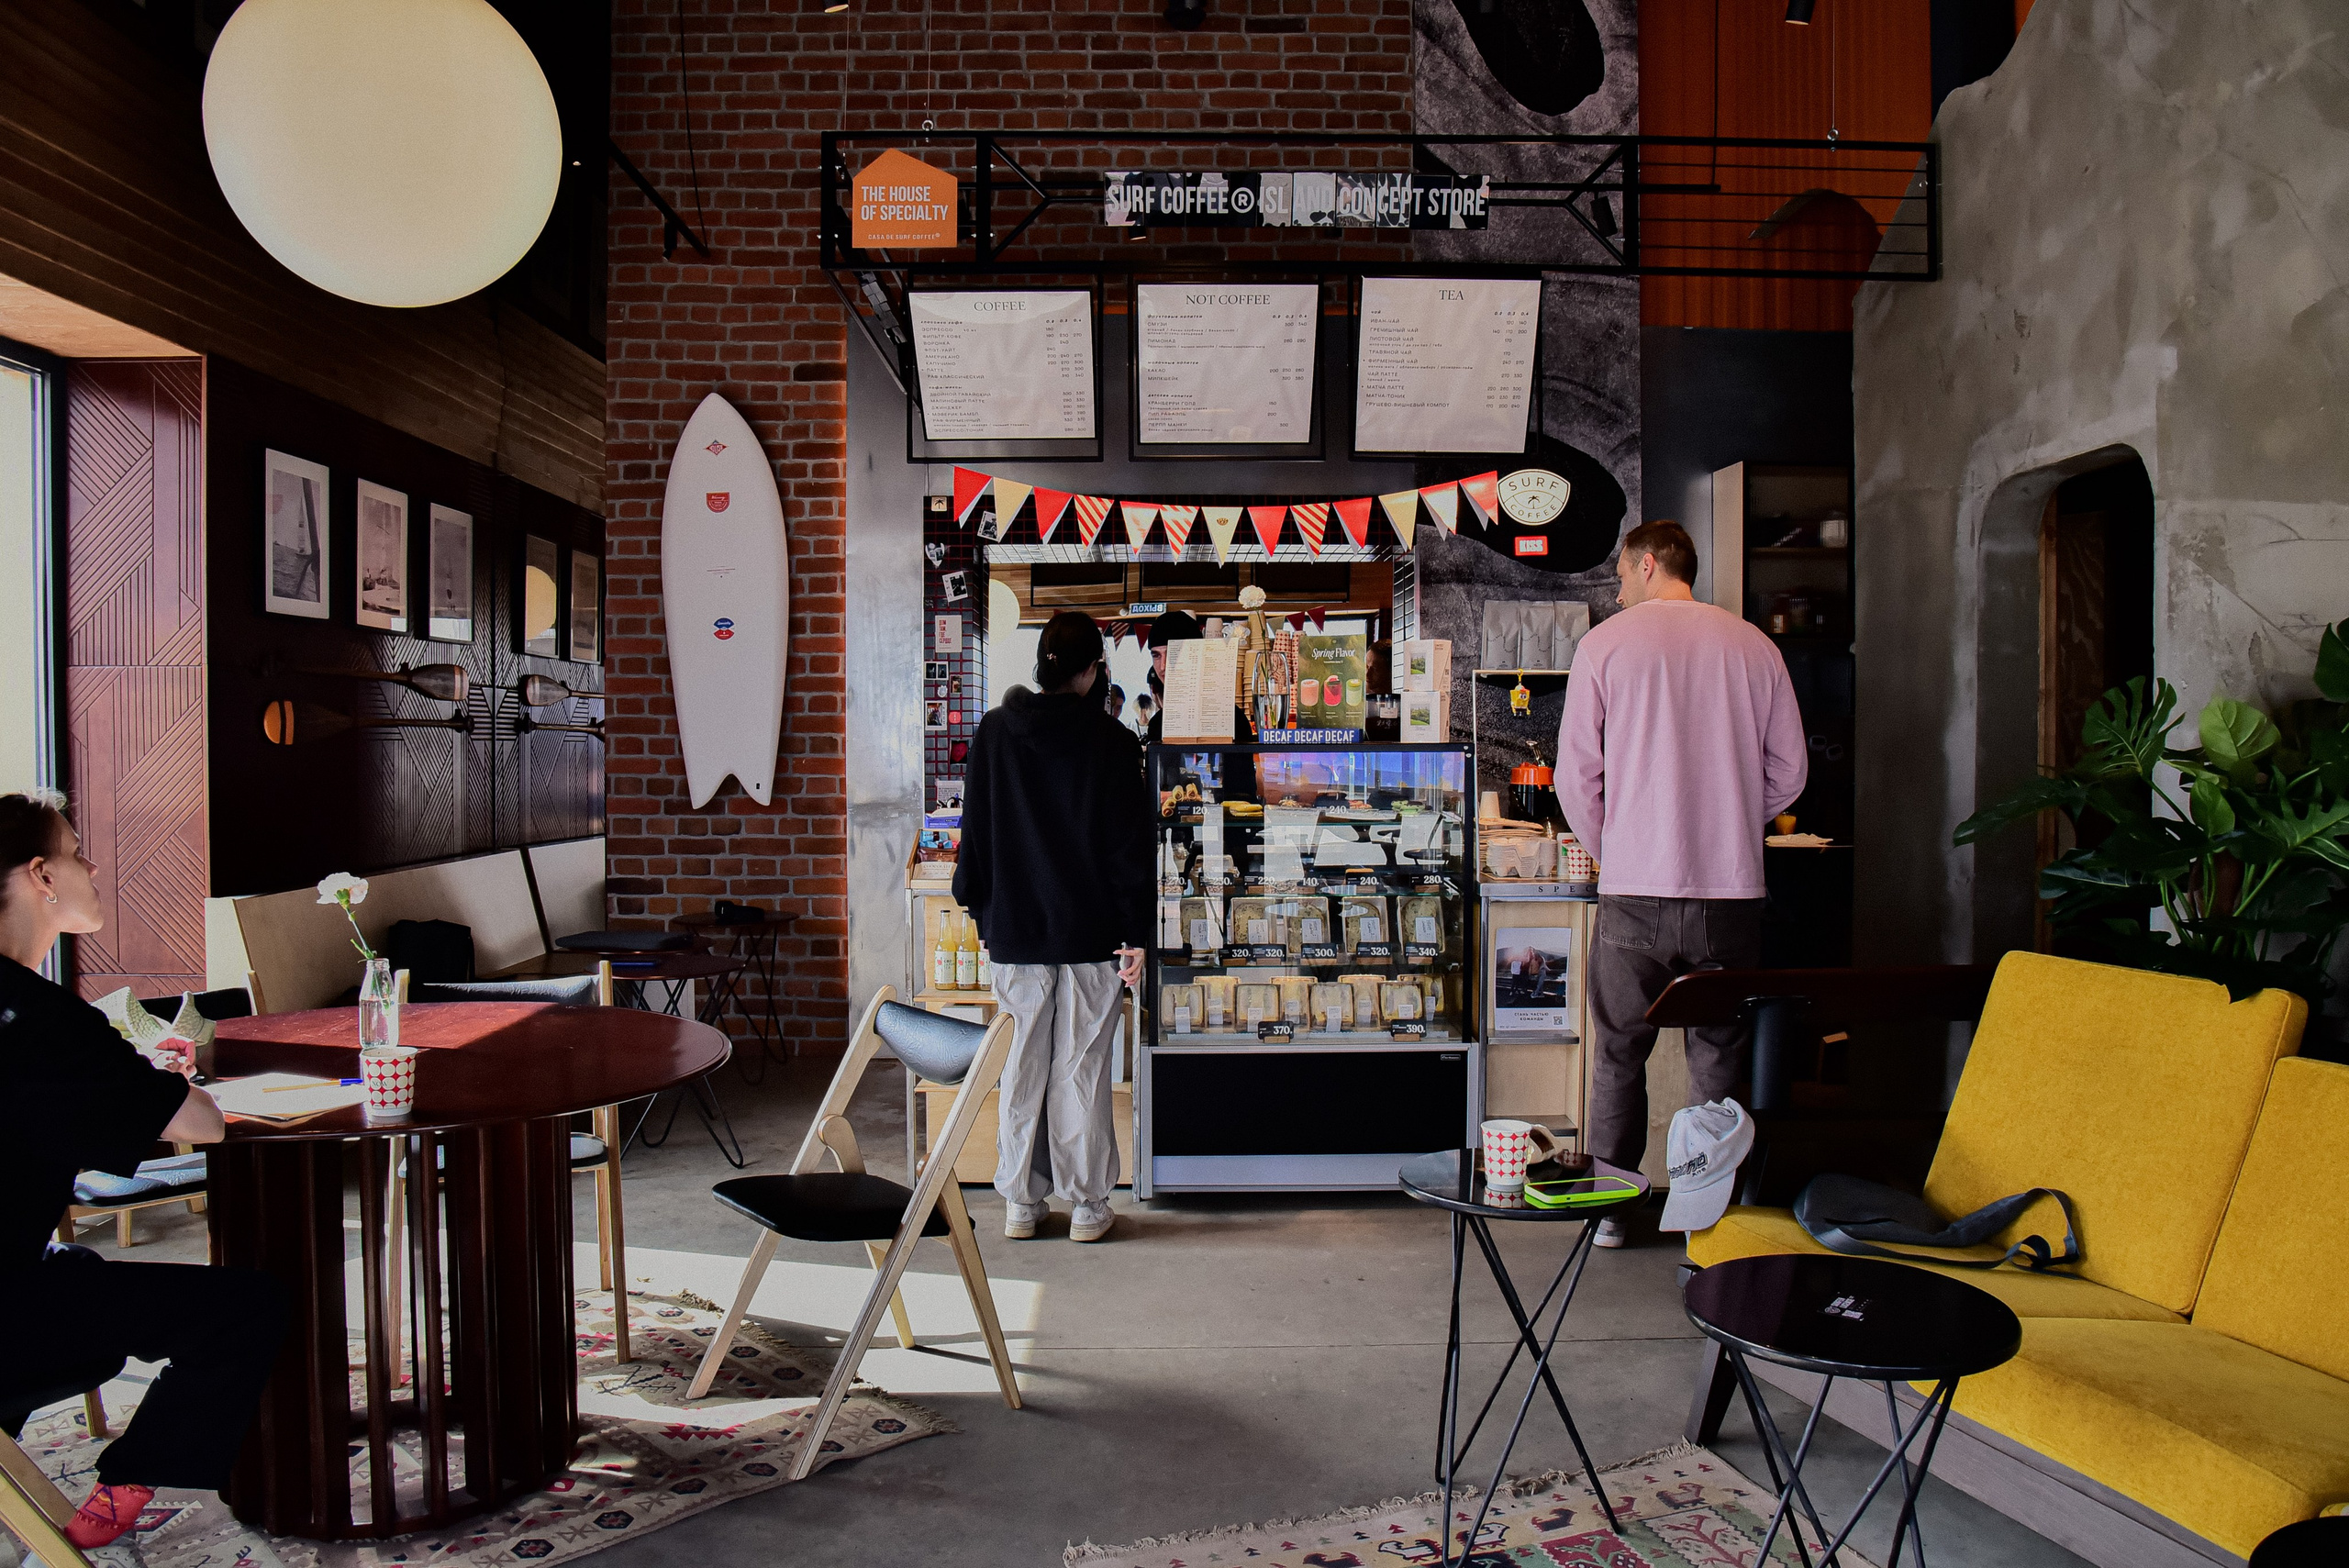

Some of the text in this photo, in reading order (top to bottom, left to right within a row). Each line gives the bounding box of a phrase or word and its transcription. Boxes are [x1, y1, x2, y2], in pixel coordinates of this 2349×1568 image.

[862, 186, 930, 202] THE HOUSE
[1108, 184, 1154, 214] SURF
[1260, 186, 1335, 214] ISLAND
[1340, 187, 1419, 215] CONCEPT
[1428, 189, 1486, 217] STORE
[861, 205, 949, 221] OF SPECIALTY
[1186, 295, 1270, 305] NOT COFFEE
[1439, 290, 1464, 300] TEA
[974, 302, 1026, 311] COFFEE
[1508, 477, 1559, 491] SURF
[1510, 504, 1556, 518] COFFEE
[1312, 648, 1355, 660] Spring Flavor
[1264, 730, 1354, 742] DECAF DECAF DECAF
